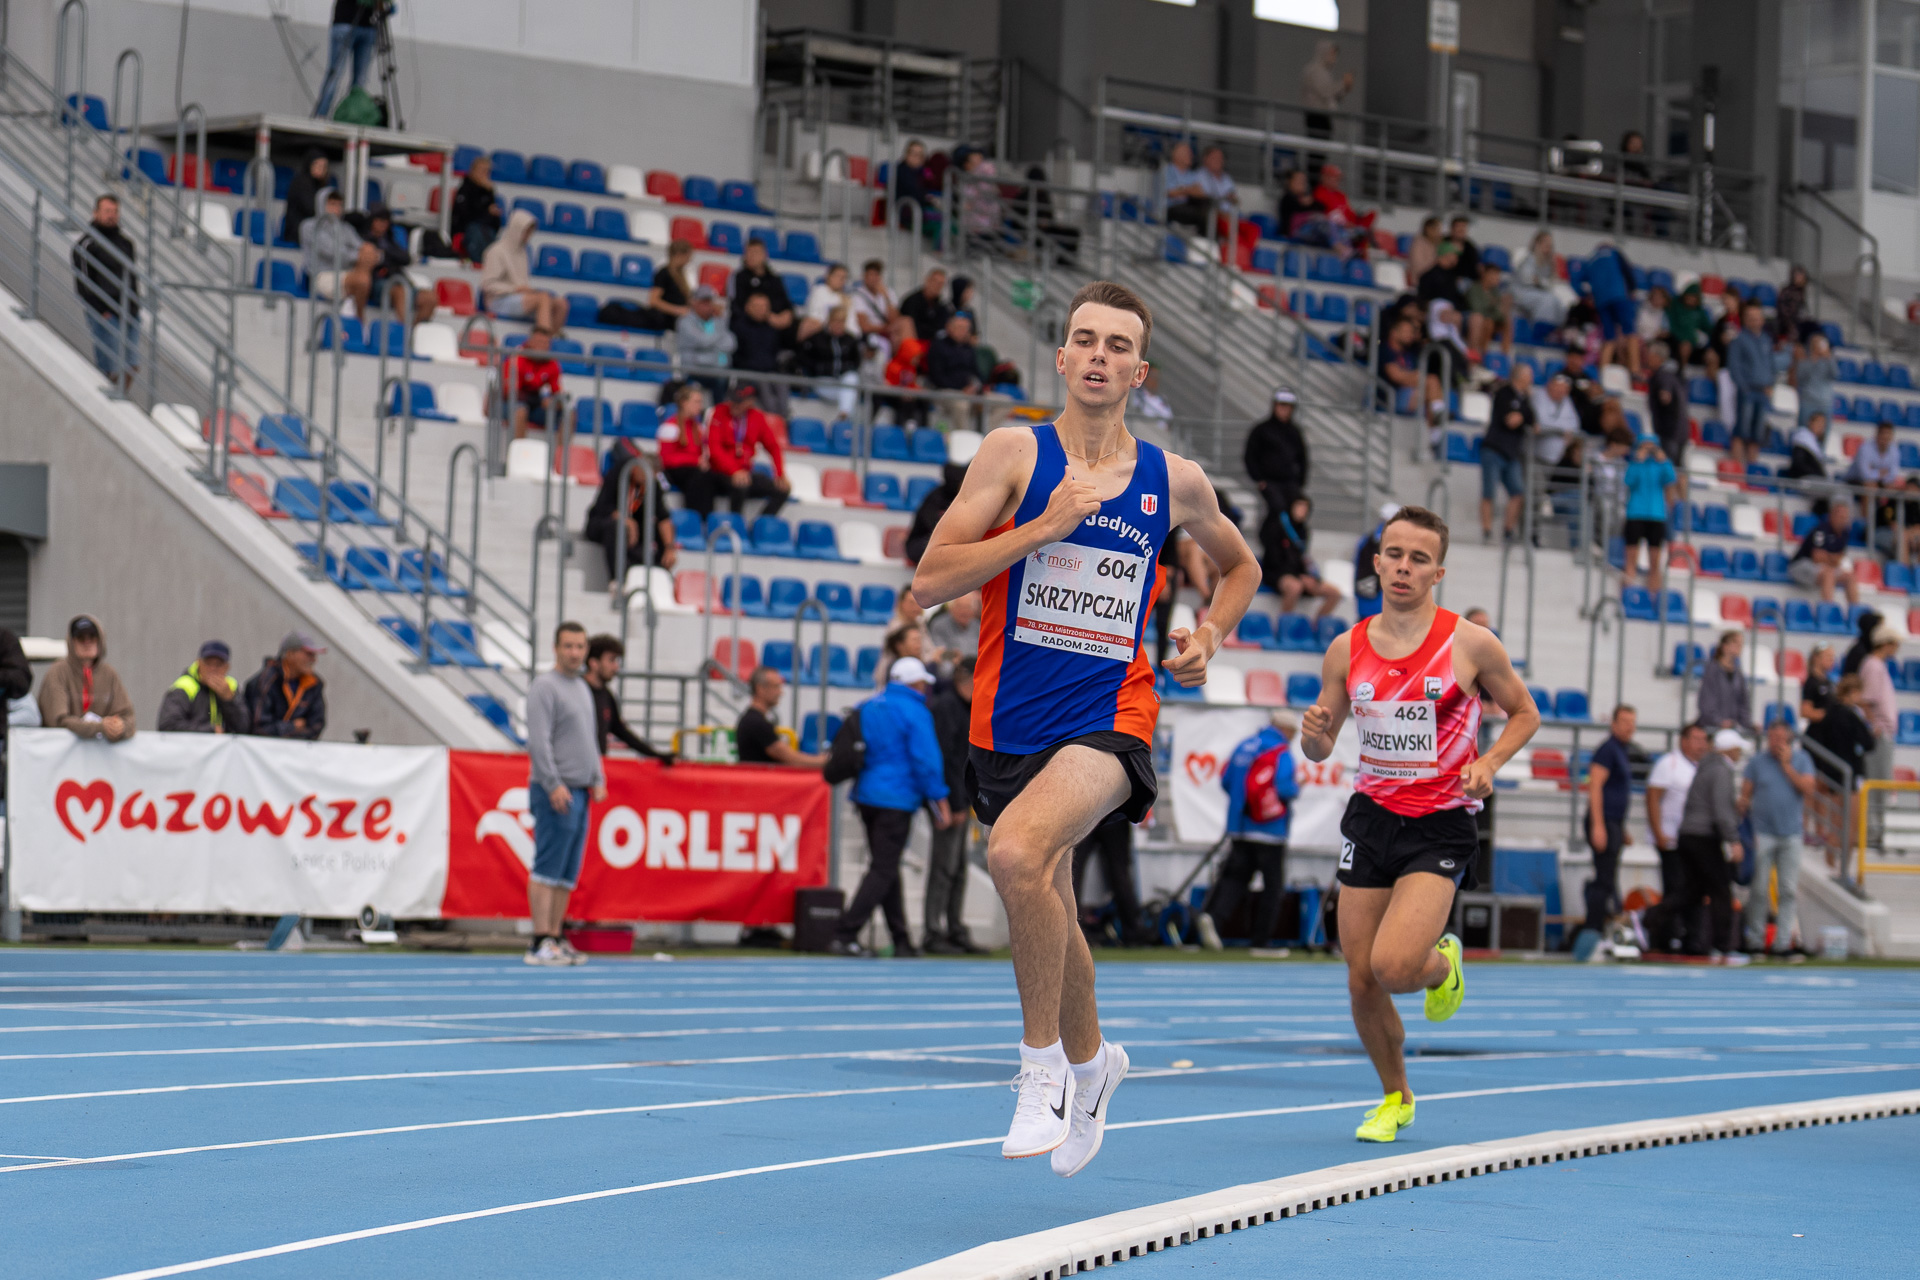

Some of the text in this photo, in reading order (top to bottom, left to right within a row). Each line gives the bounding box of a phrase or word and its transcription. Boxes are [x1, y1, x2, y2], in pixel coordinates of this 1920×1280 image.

[1085, 514, 1154, 560] Jedynka
[1047, 554, 1083, 570] mosir
[1097, 557, 1138, 582] 604
[1024, 582, 1136, 624] SKRZYPCZAK
[1027, 621, 1128, 645] 78. PZLA Mistrzostwa Polski U20
[1041, 635, 1109, 655] RADOM 2024
[1394, 706, 1428, 721] 462
[1362, 729, 1432, 751] JASZEWSKI
[1372, 767, 1397, 776] RADOM
[598, 804, 801, 873] ORLEN
[1342, 842, 1353, 863] 2
